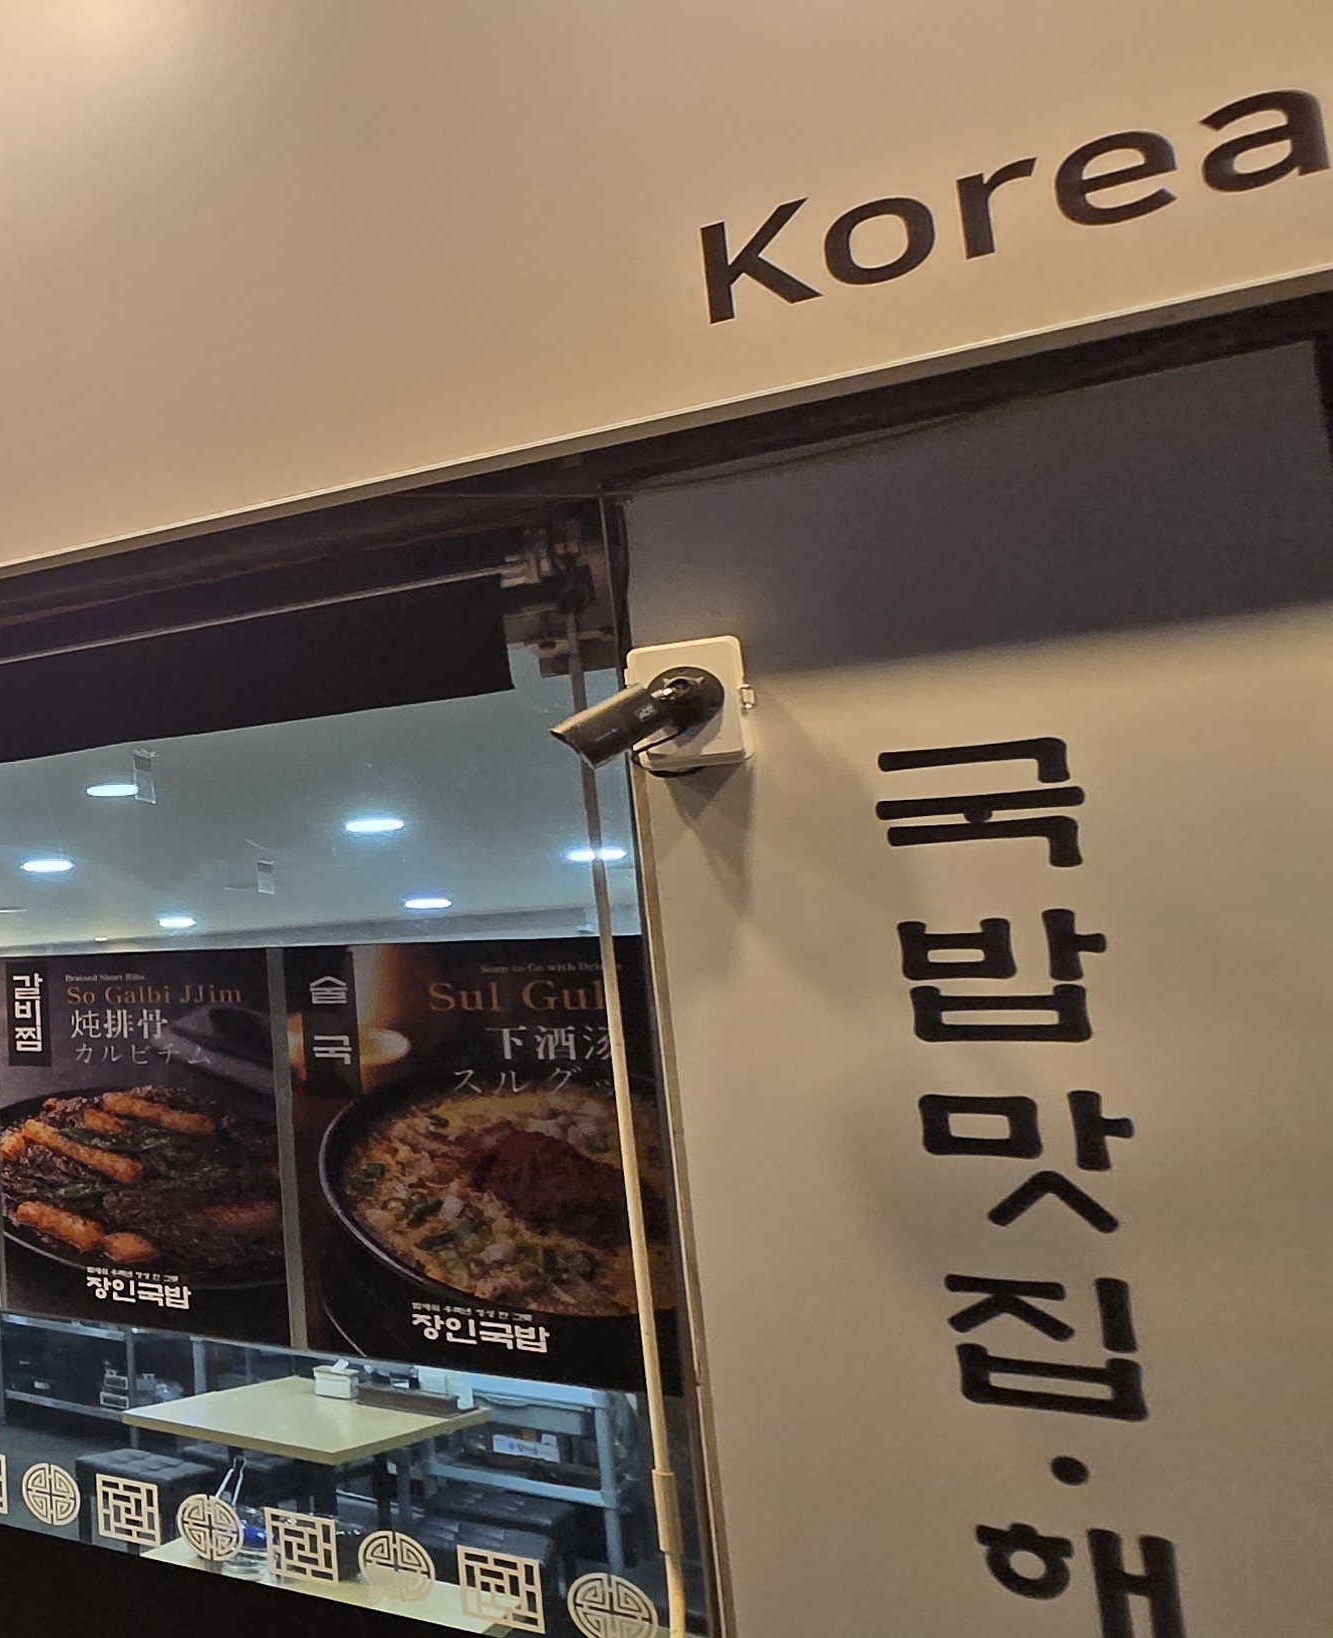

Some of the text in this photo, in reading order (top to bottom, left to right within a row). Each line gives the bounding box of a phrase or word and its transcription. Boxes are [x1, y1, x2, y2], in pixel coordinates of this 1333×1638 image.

[700, 88, 1330, 325] Korea
[67, 986, 96, 1005] So
[104, 985, 171, 1004] Galbi
[429, 982, 501, 1012] Sul
[13, 973, 43, 1053] 갈비찜
[71, 1009, 169, 1039] 炖排骨
[309, 975, 352, 1066] 술국
[75, 1043, 211, 1065] カルビチム
[86, 1276, 192, 1310] 장인국밥
[412, 1313, 550, 1353] 장인국밥
